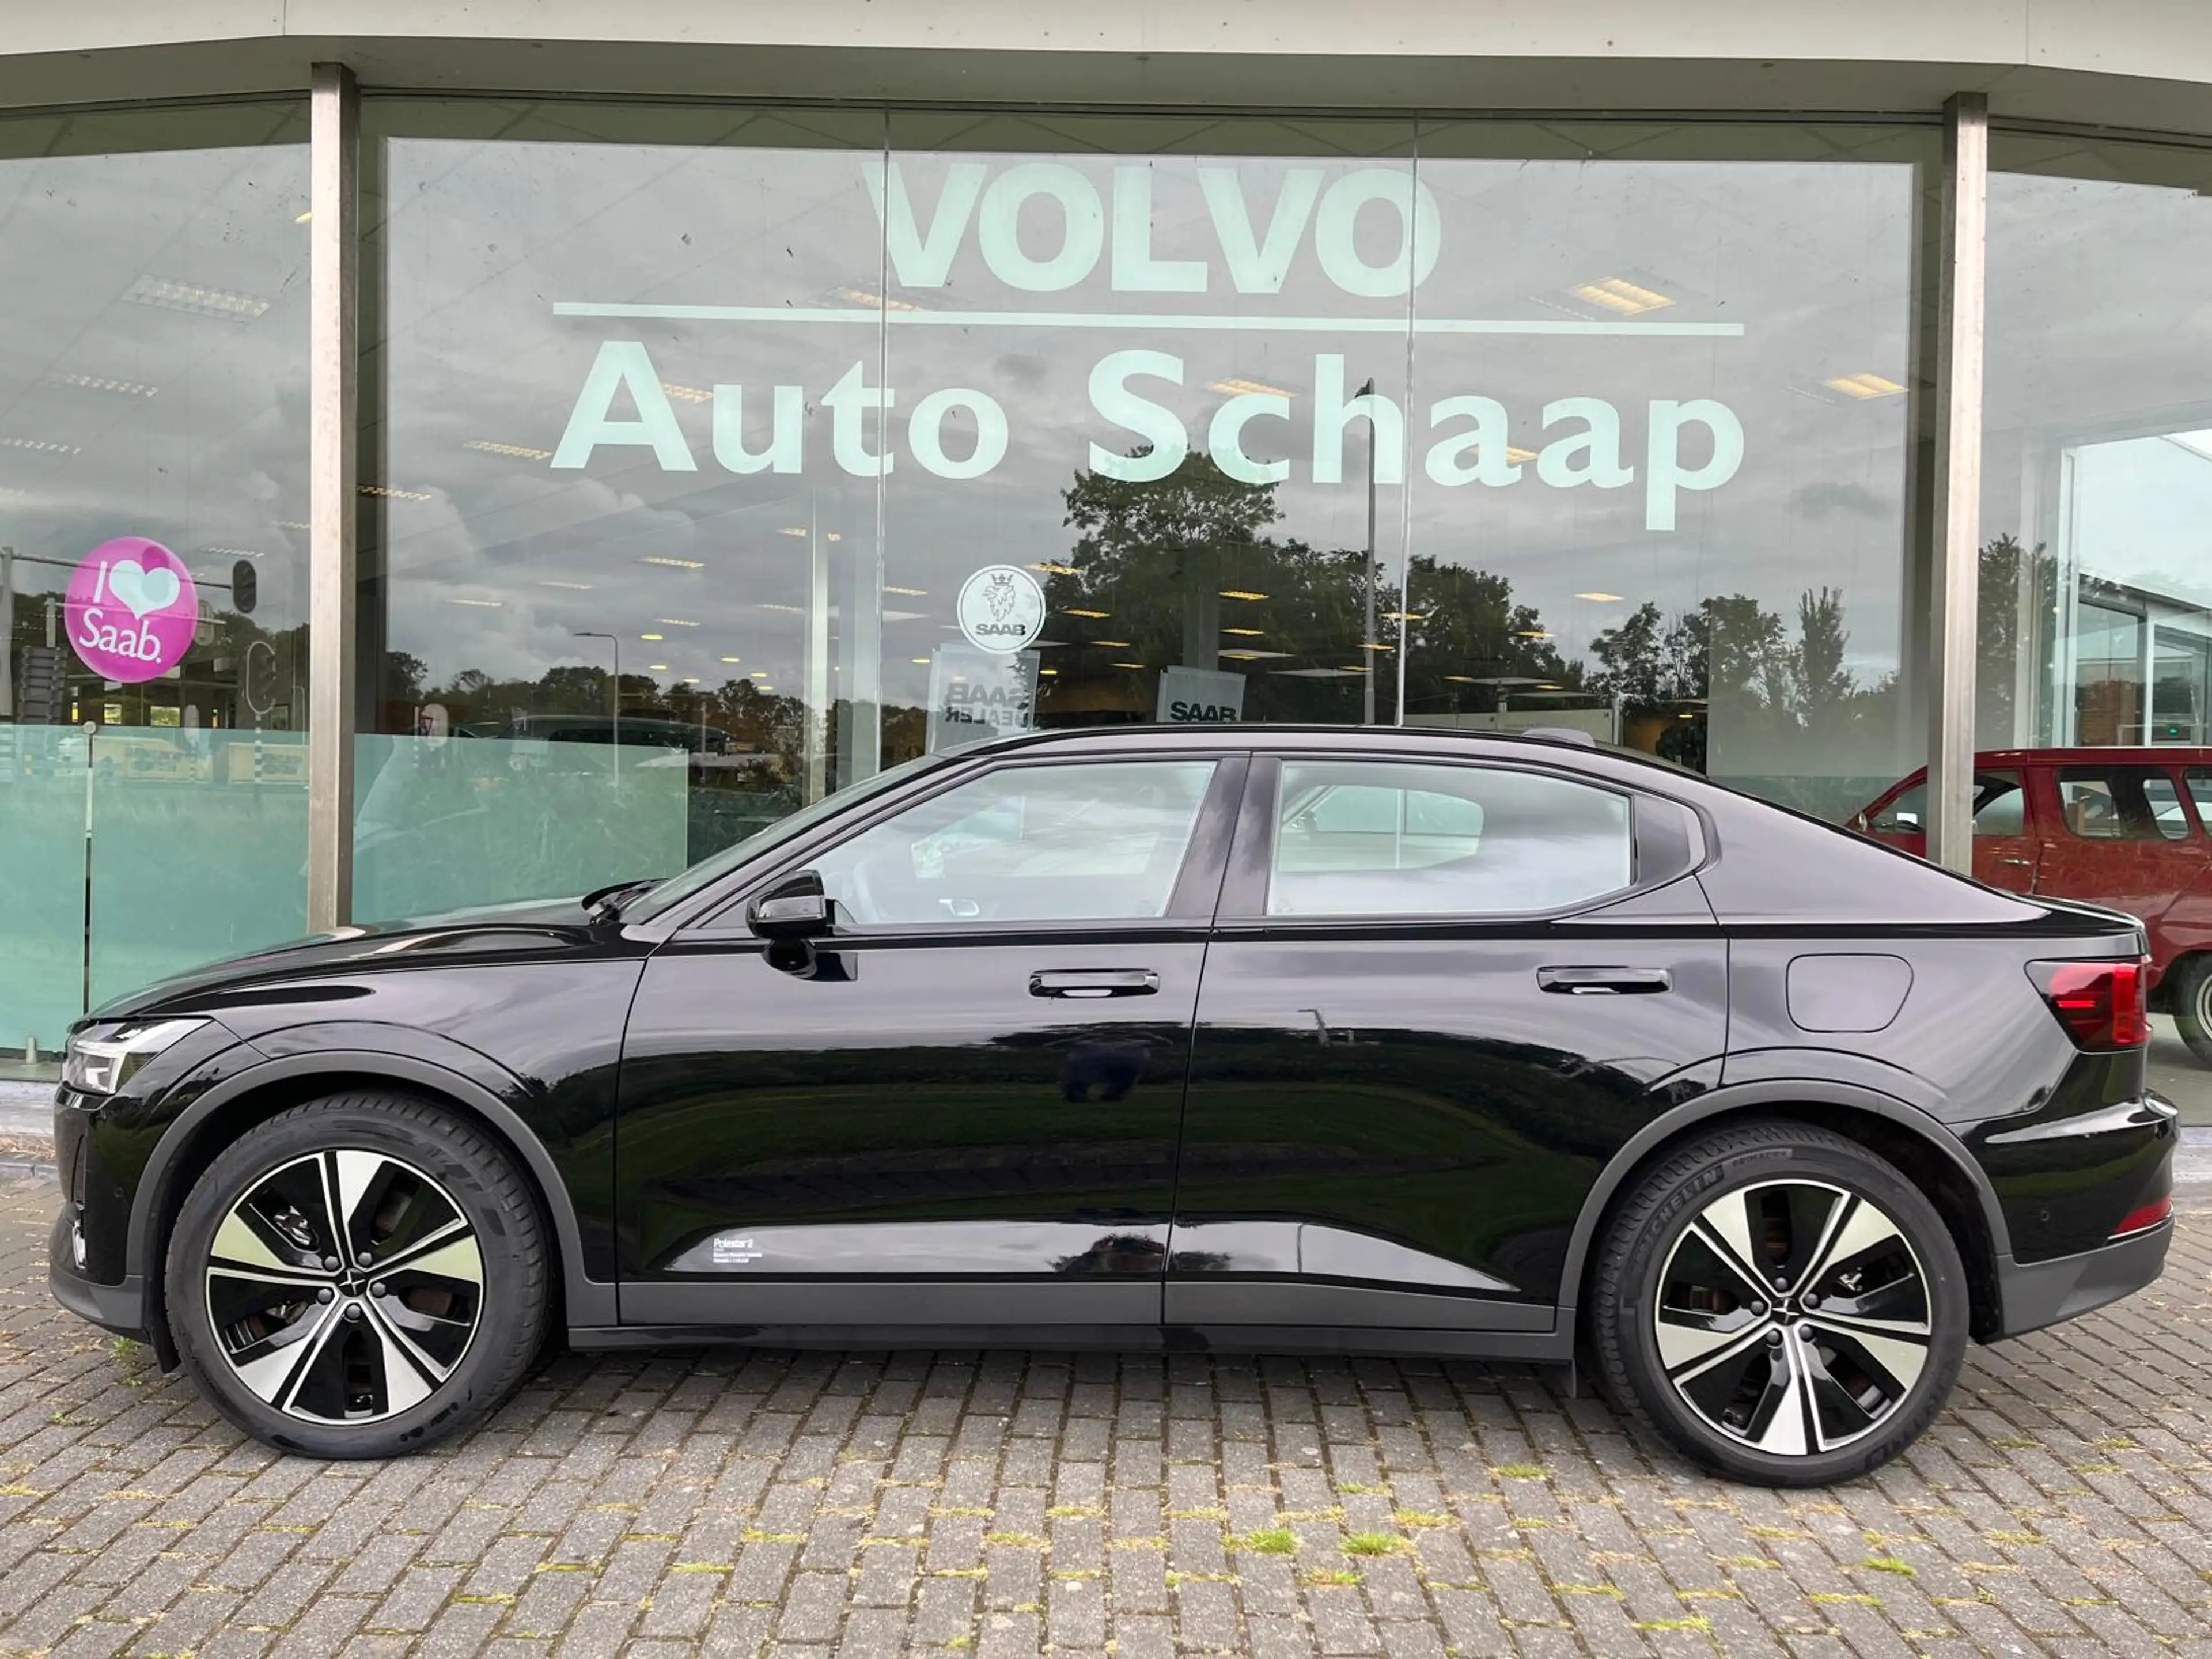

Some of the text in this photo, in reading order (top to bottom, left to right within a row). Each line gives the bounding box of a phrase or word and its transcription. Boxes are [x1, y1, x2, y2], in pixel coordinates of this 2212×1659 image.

[861, 162, 1441, 297] VOLVO
[550, 340, 1745, 531] Auto Schaap
[975, 623, 1026, 636] SAAB
